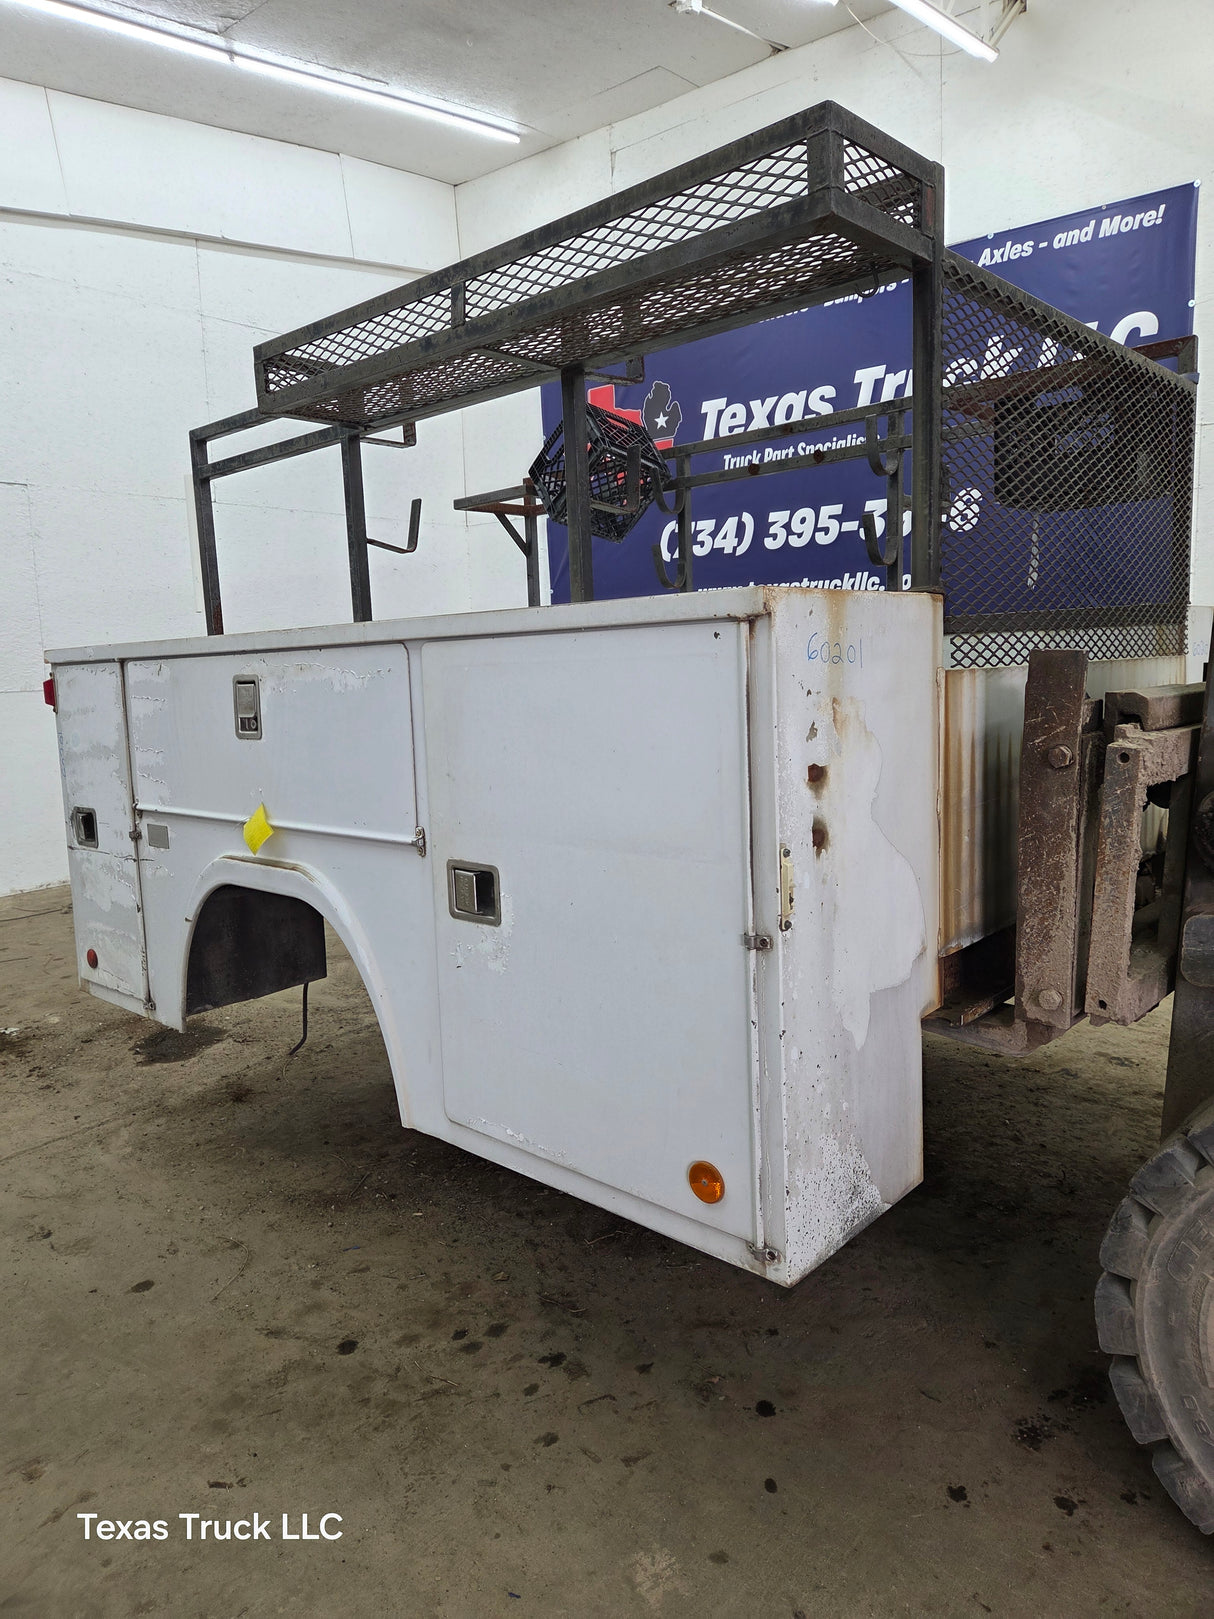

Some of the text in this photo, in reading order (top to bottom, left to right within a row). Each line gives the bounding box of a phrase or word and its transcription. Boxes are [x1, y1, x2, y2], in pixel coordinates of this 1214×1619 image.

[977, 240, 1035, 268] Axles
[1053, 220, 1096, 250] and
[1099, 203, 1166, 239] More!
[701, 384, 837, 441] Texas
[853, 334, 1024, 409] Trck
[723, 450, 761, 471] Truck
[763, 487, 982, 550] 395-38
[807, 632, 863, 669] 60201
